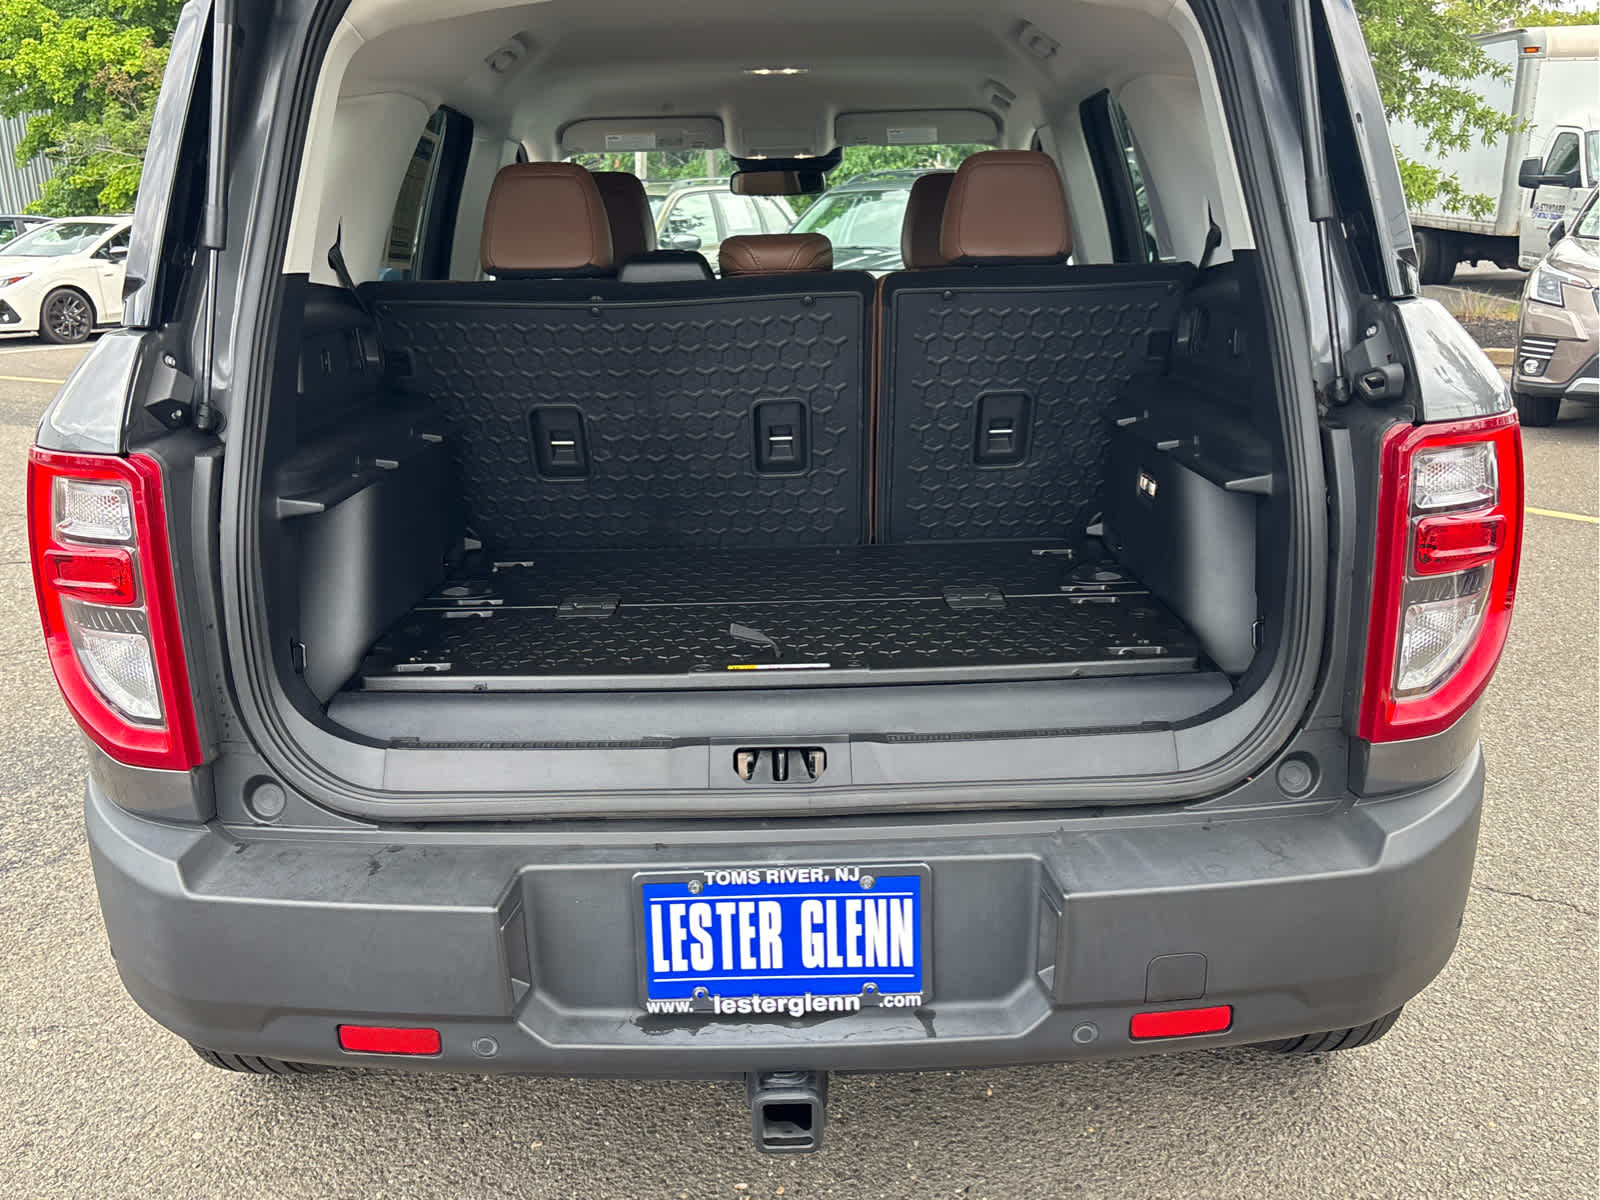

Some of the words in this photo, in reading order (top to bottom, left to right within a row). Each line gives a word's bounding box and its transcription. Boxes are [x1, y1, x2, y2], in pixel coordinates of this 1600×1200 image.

[704, 870, 761, 886] TOMS
[766, 868, 830, 884] RIVER,
[835, 866, 861, 881] NJ
[650, 900, 784, 973] LESTER
[800, 898, 914, 969] GLENN
[647, 1000, 694, 1013] www.
[713, 994, 860, 1017] lesterglenn
[879, 994, 922, 1008] .com
